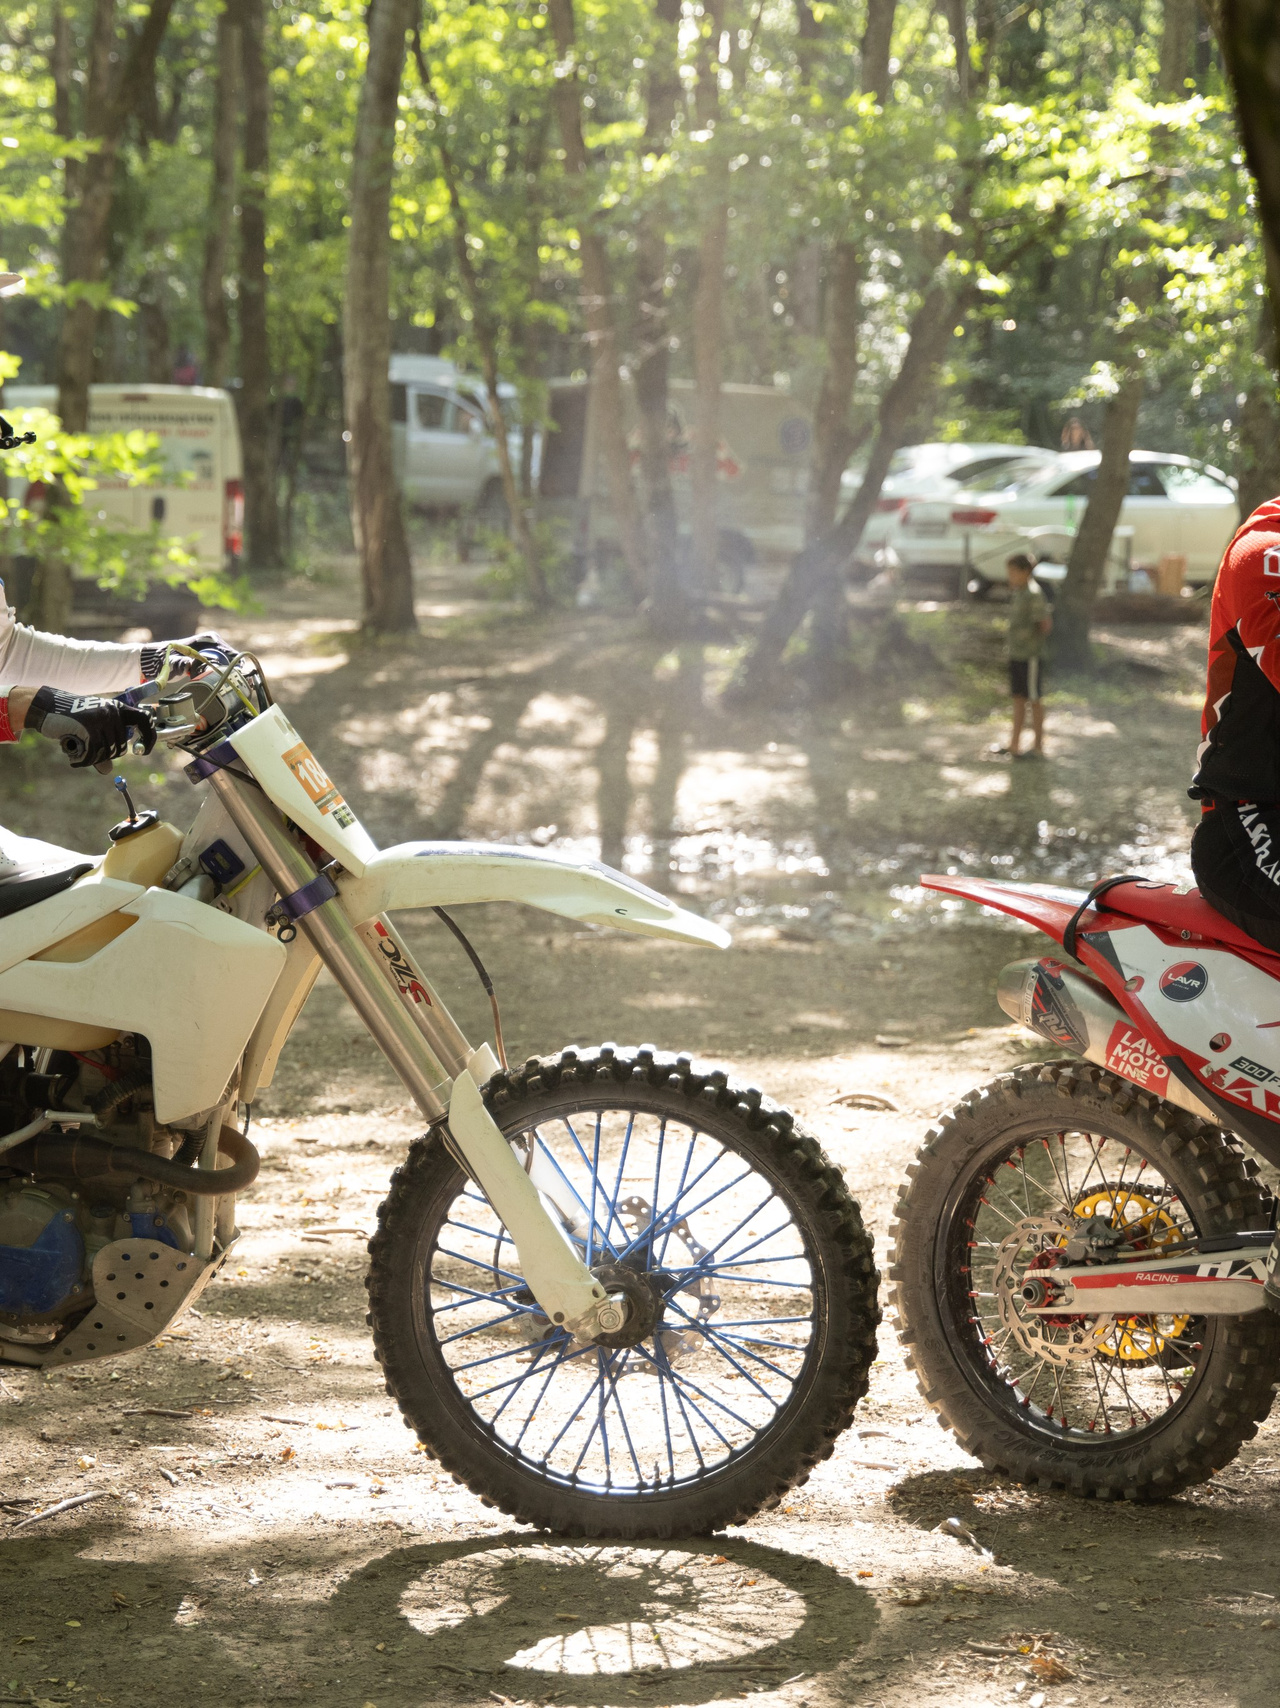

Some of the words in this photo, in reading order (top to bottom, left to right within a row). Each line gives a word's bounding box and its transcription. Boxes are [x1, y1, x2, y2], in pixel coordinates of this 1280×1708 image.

[1168, 973, 1201, 989] LAVR
[1120, 1030, 1165, 1063] LAV
[1108, 1056, 1149, 1084] LINE
[1113, 1043, 1168, 1078] MOTO
[1234, 1060, 1269, 1078] 300
[1135, 1273, 1179, 1283] RACING
